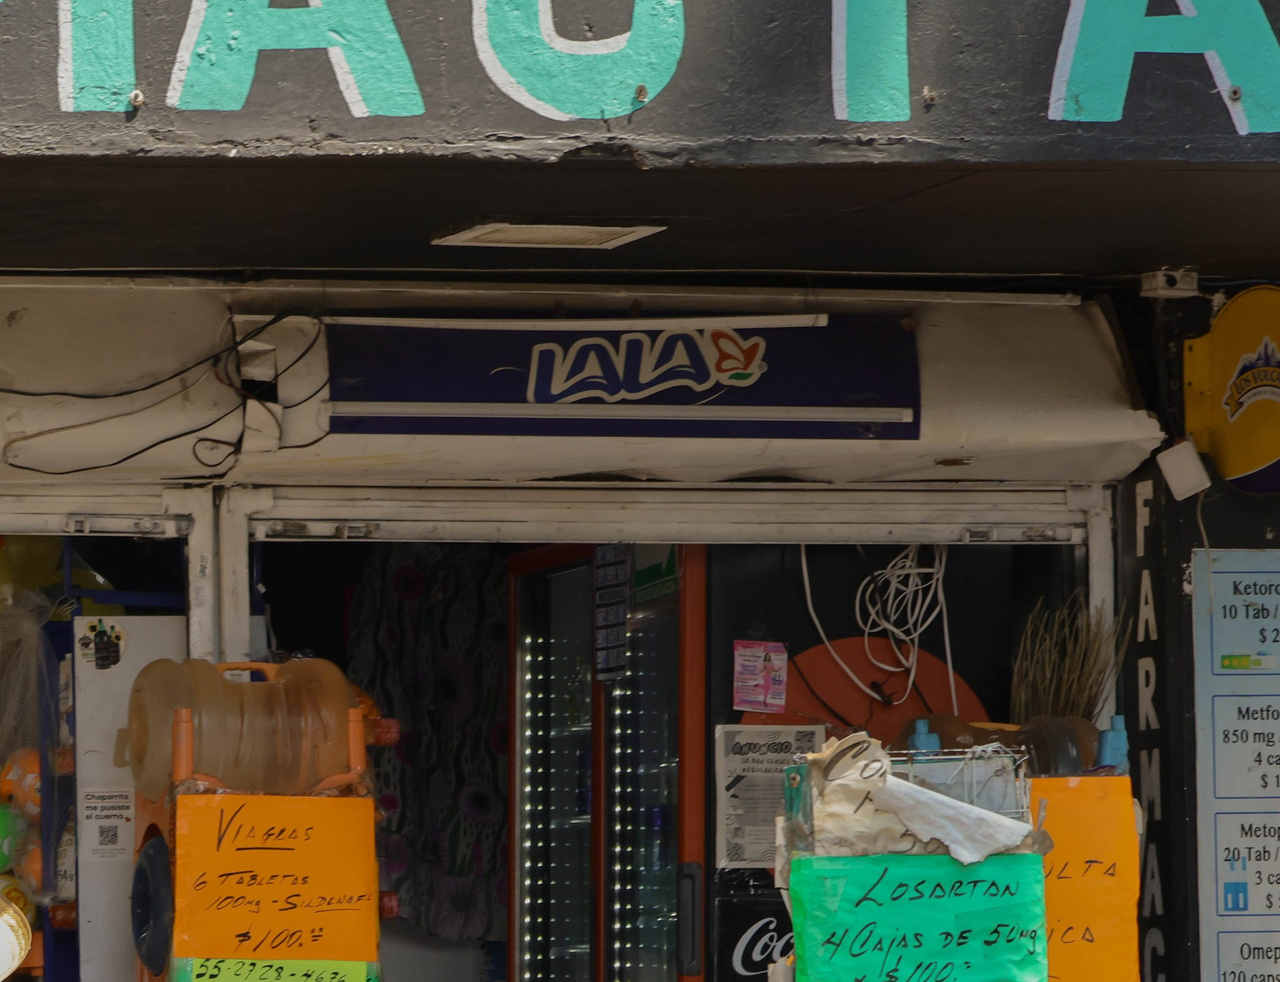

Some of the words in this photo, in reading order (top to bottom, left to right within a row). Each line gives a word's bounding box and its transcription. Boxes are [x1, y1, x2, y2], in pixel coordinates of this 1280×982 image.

[527, 329, 713, 404] LALA
[1221, 604, 1238, 620] 10
[1243, 604, 1270, 620] Tab
[1222, 729, 1249, 744] 850
[1253, 732, 1275, 748] mg
[1254, 752, 1263, 766] 4
[1223, 846, 1241, 862] 20
[1245, 846, 1271, 862] Tab
[193, 871, 208, 891] 6
[855, 867, 1019, 908] LOSARTAN
[939, 929, 973, 949] DE
